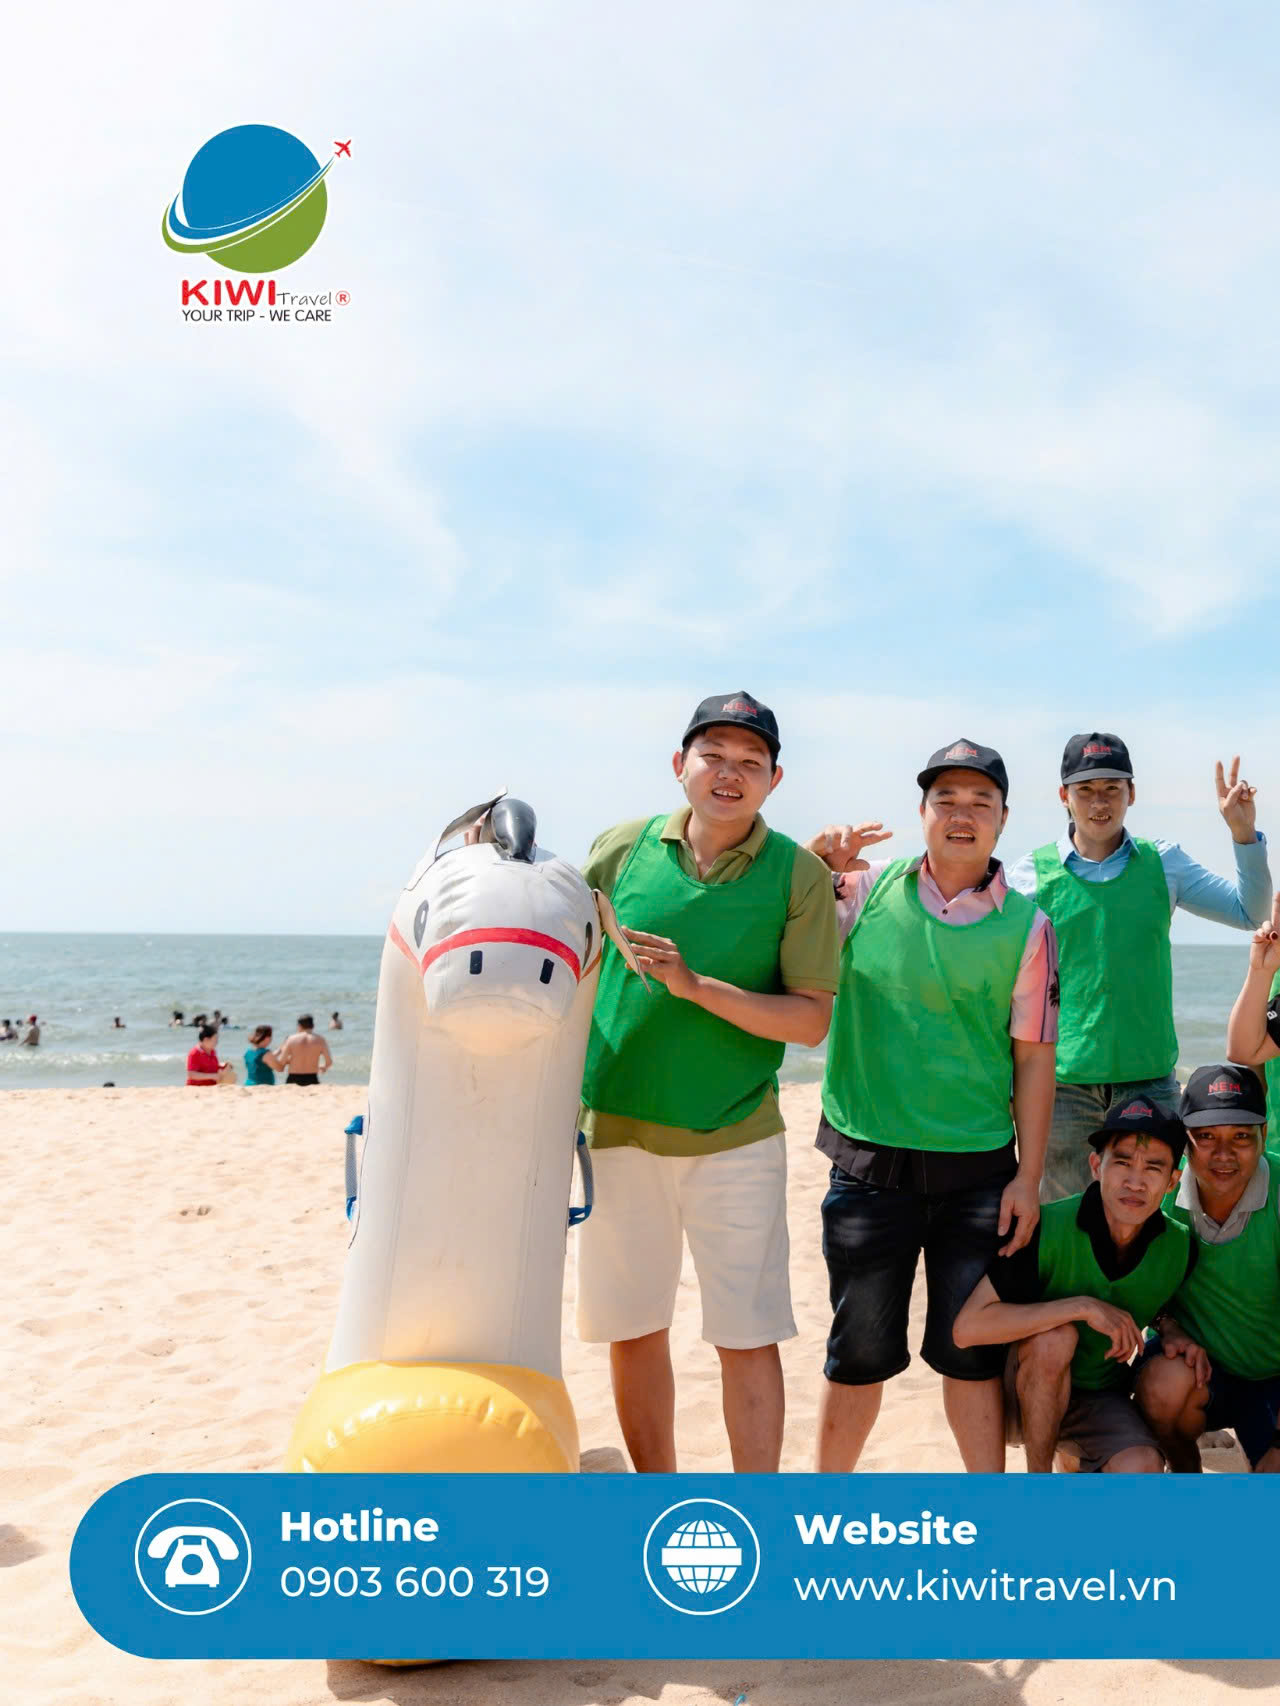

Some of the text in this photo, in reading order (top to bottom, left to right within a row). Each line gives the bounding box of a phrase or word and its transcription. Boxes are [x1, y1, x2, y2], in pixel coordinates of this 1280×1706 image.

[721, 702, 758, 716] NEM
[945, 747, 977, 759] NEM
[1082, 744, 1112, 756] NEM
[1208, 1081, 1241, 1094] NEM
[1121, 1105, 1153, 1117] NEM
